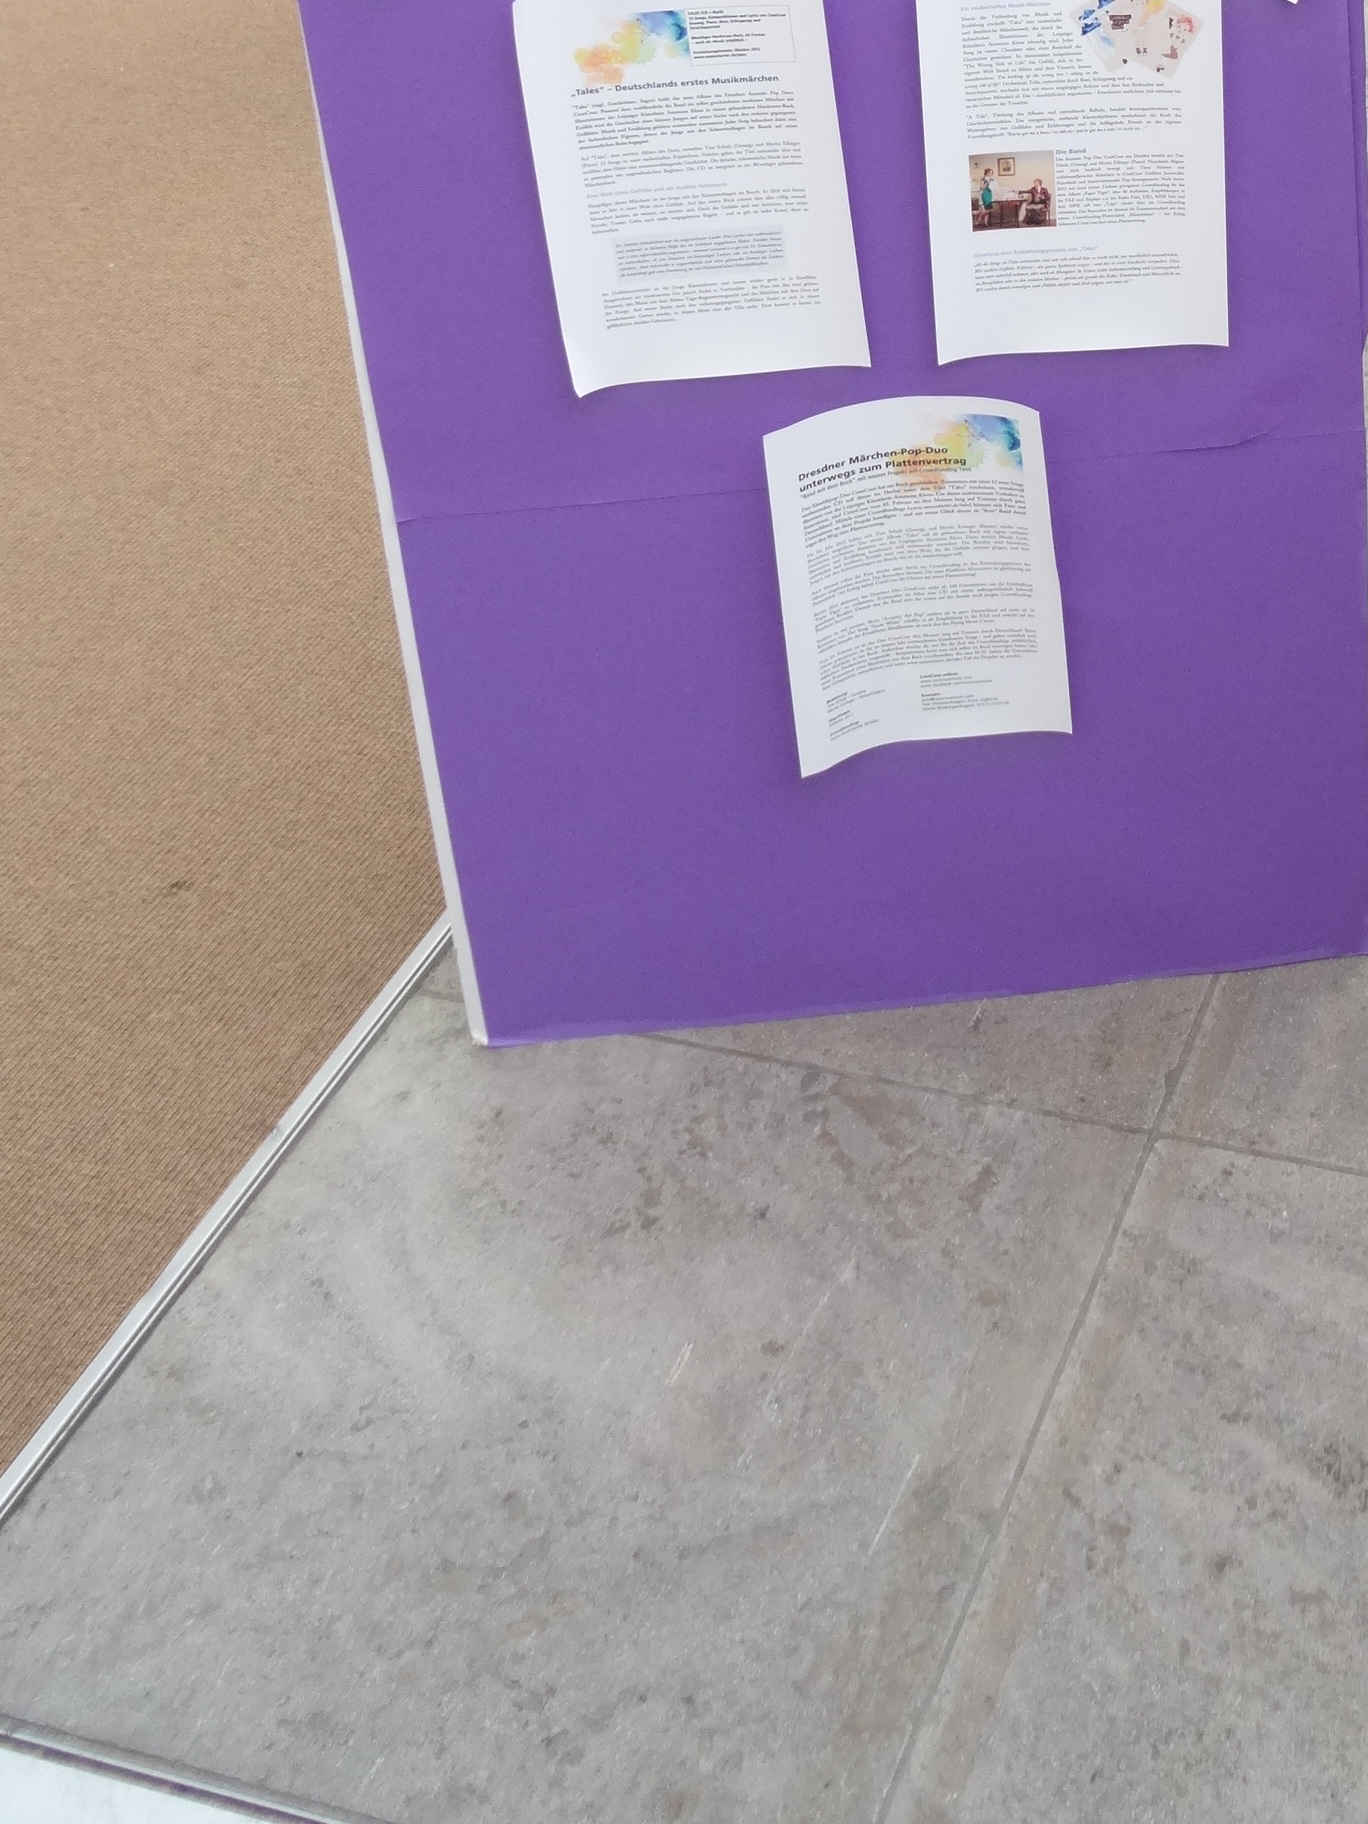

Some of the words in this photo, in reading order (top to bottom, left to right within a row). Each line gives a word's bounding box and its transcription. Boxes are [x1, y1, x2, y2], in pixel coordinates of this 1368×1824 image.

[615, 80, 679, 93] Deutschlands
[680, 78, 709, 87] erstes
[711, 74, 779, 85] Musikmärchen
[798, 459, 846, 482] Dresdner
[849, 446, 948, 465] Märchen-Pop-Duo
[799, 470, 856, 493] unterwegs
[858, 464, 882, 474] zum
[885, 457, 967, 469] Plattenvertrag
